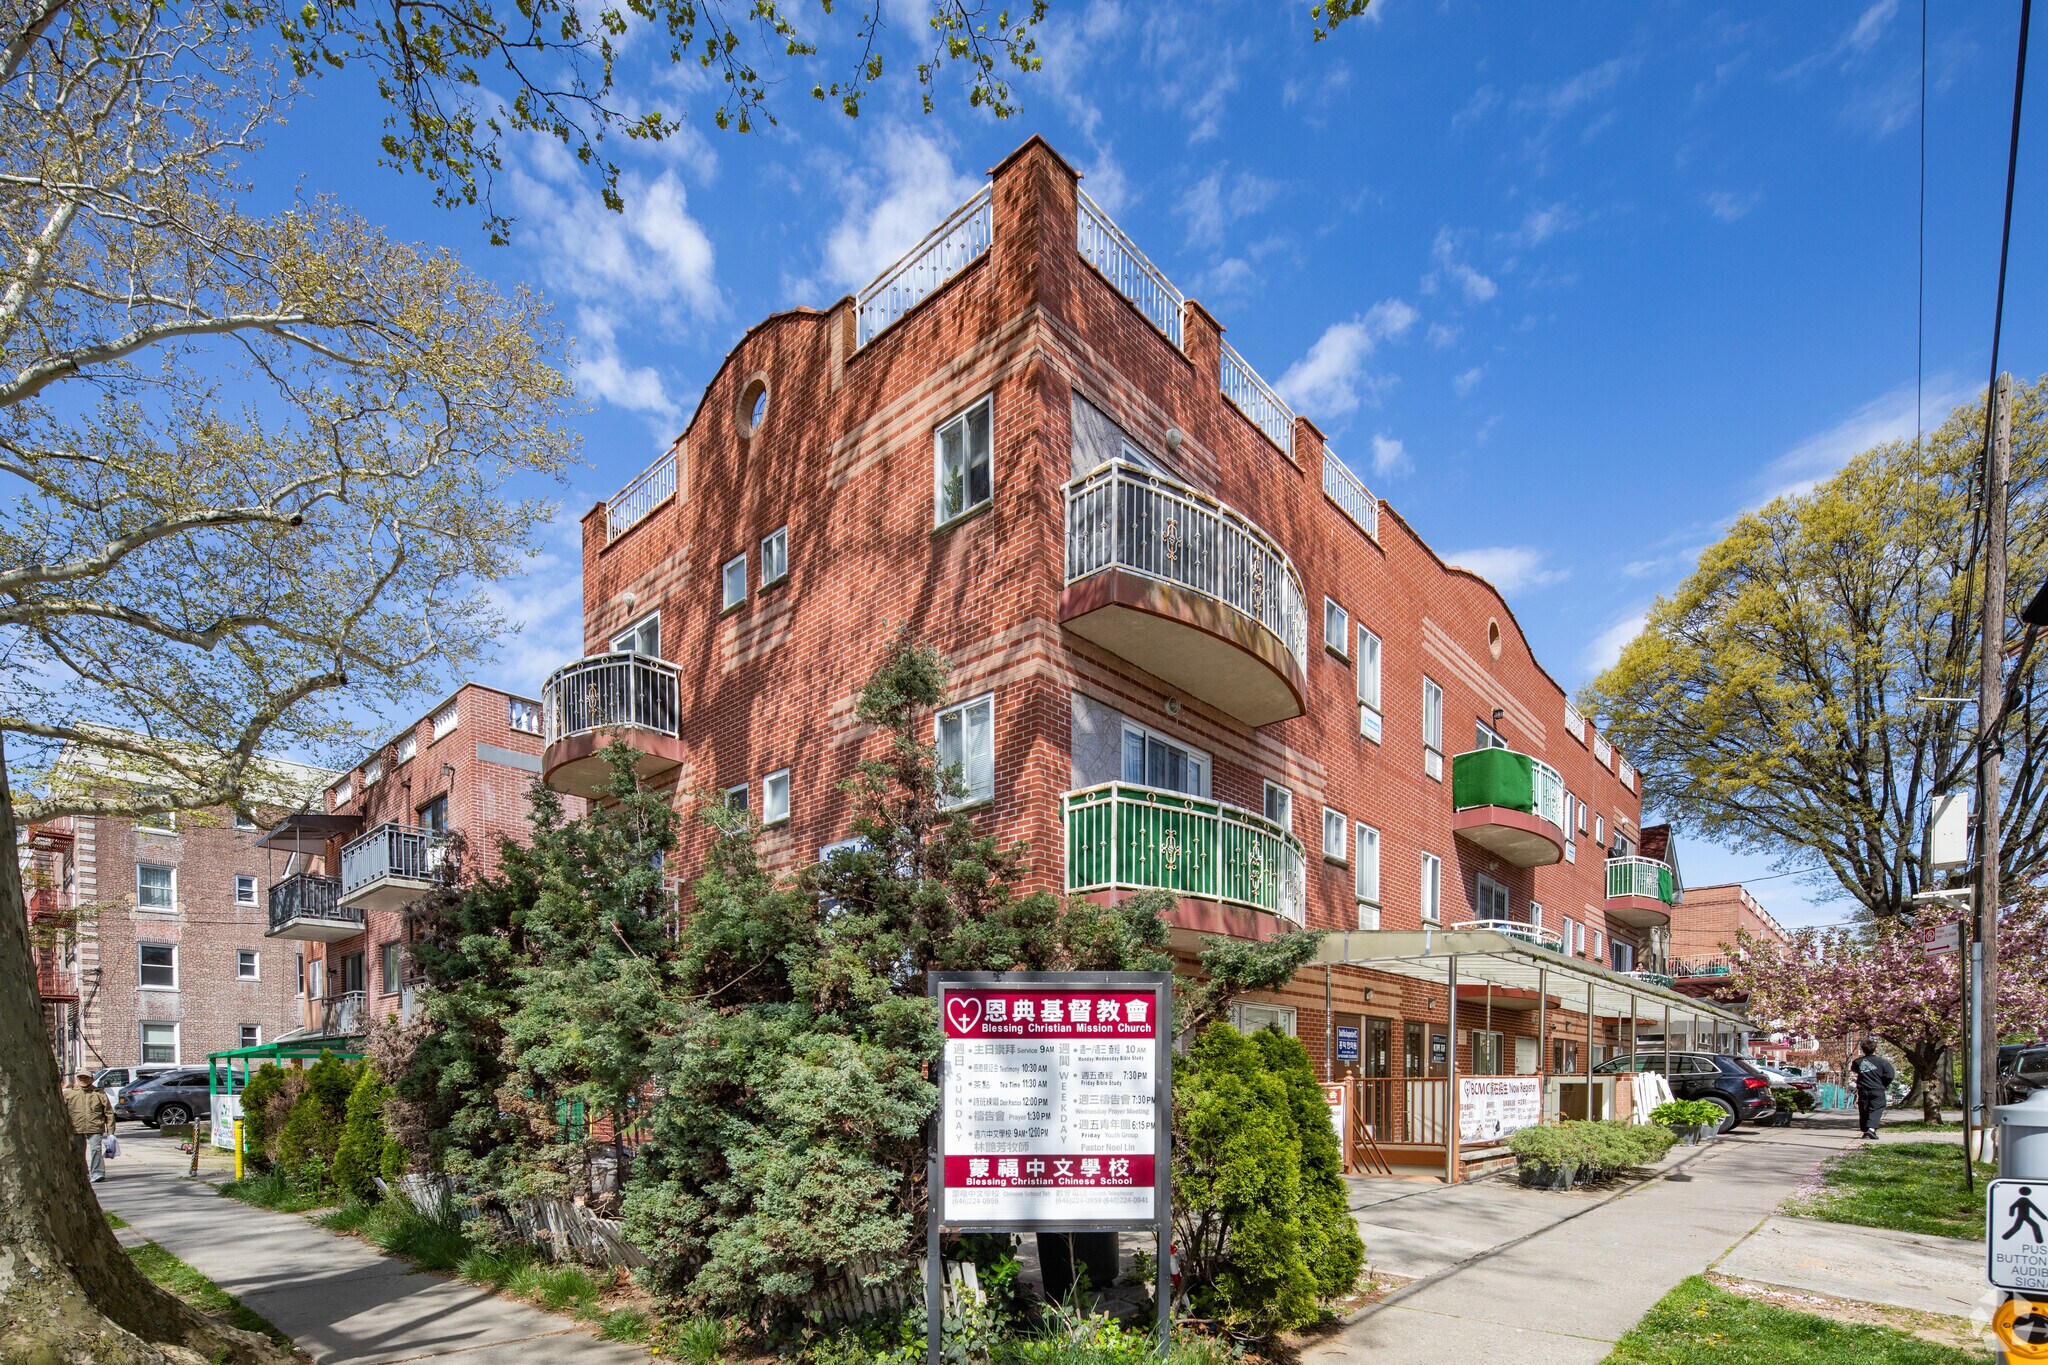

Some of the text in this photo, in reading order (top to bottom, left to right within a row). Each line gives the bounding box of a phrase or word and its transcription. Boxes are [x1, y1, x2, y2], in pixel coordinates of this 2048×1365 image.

[984, 998, 1149, 1022] 恩典基督教會
[982, 1023, 1151, 1034] Blessing Christian Mission Church
[974, 1044, 1015, 1055] 主日崇拜
[1126, 1045, 1136, 1053] 10
[1022, 1063, 1037, 1073] 10:30
[1038, 1064, 1048, 1073] AM
[1123, 1071, 1136, 1080] 7:30
[1137, 1072, 1148, 1080] PM
[1037, 1080, 1048, 1088] AM
[1509, 1082, 1520, 1093] Now
[1132, 1095, 1146, 1104] 7:30
[974, 1110, 1005, 1121] 禱告會
[1008, 1114, 1027, 1122] Prayer
[1131, 1120, 1145, 1130] 6:15
[1106, 1143, 1123, 1151] Noel
[1125, 1143, 1136, 1151] Lin
[968, 1158, 1129, 1178] 蒙福中文學校
[966, 1178, 1007, 1187] Blessing
[1058, 1177, 1096, 1185] Chinese
[1100, 1177, 1133, 1185] School
[1996, 1253, 2047, 1266] BUTTON
